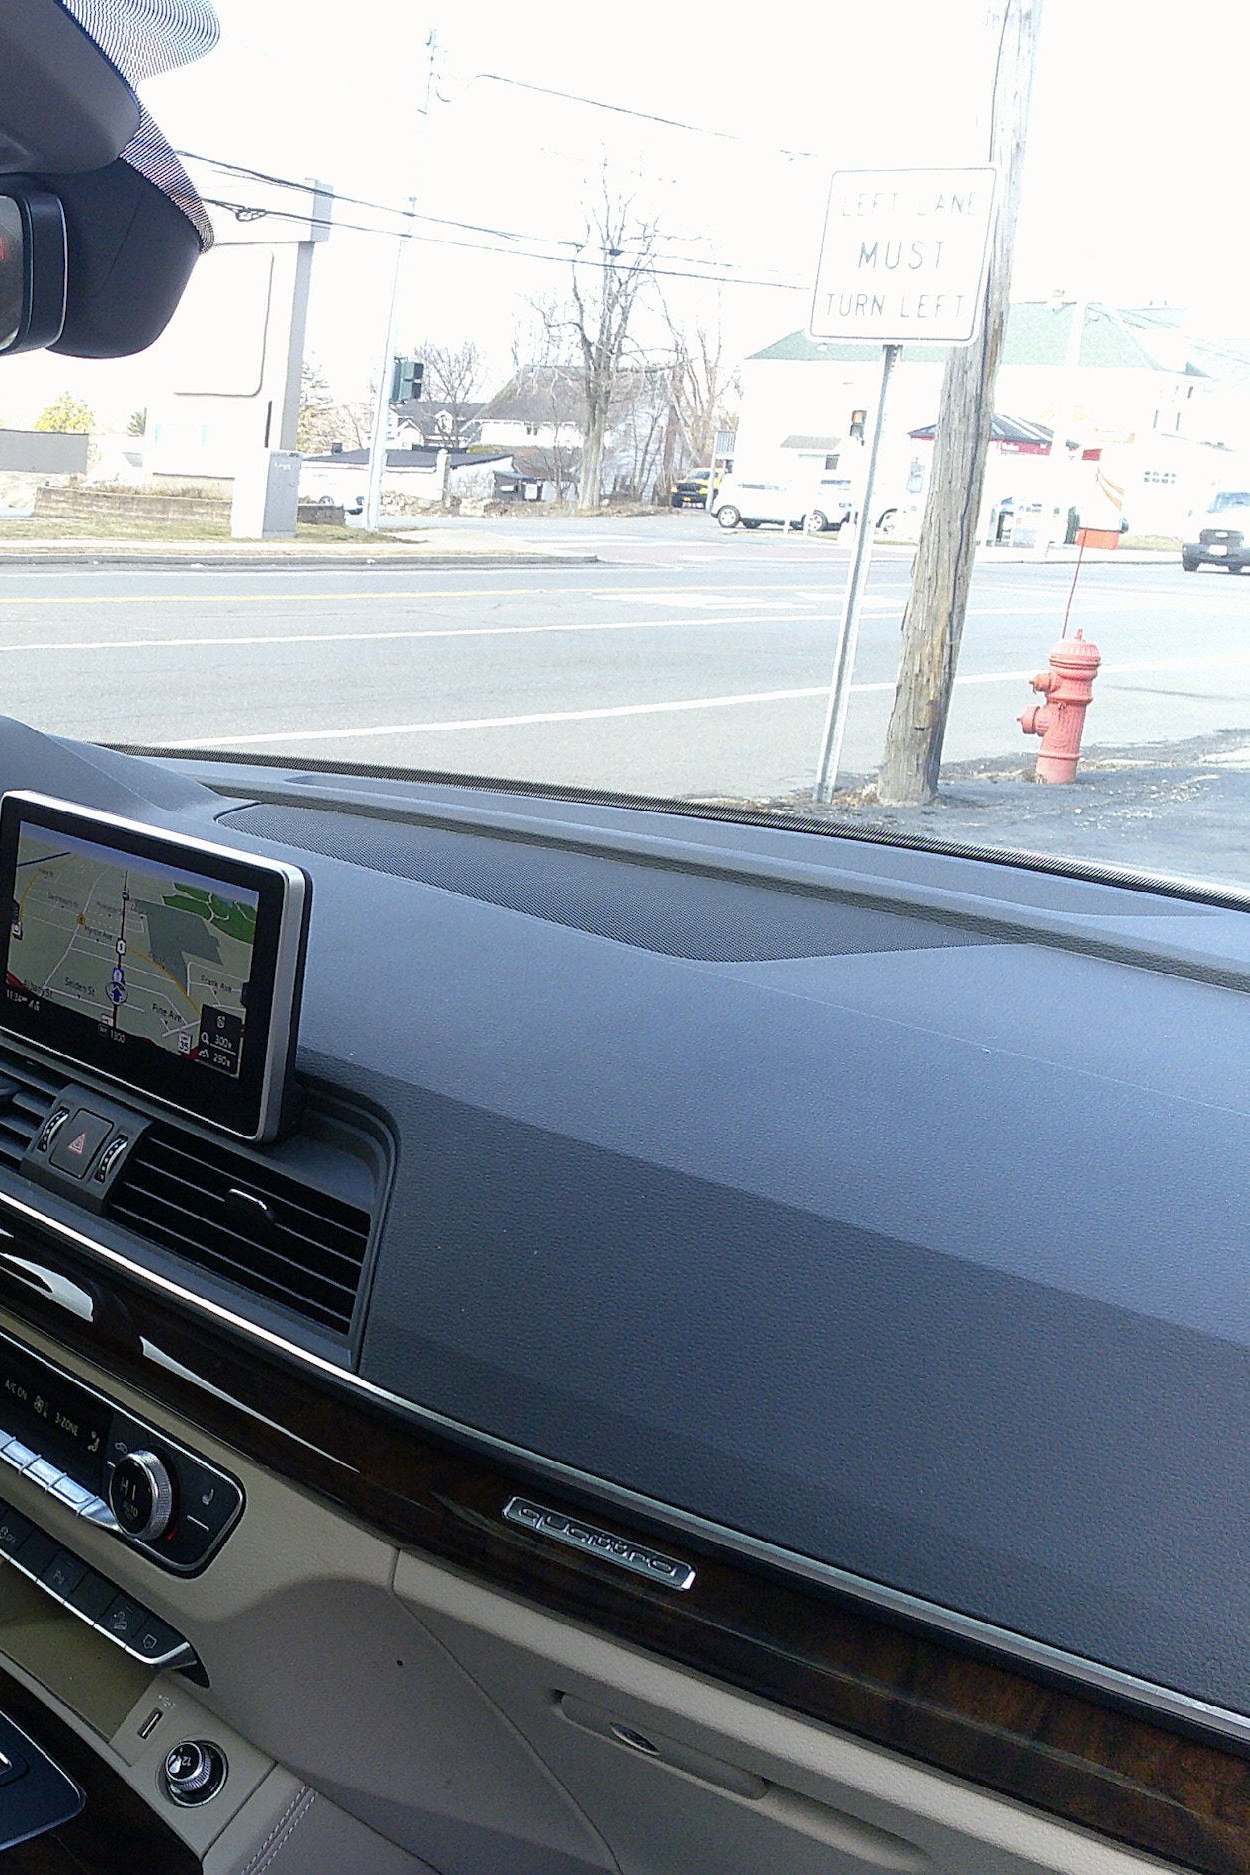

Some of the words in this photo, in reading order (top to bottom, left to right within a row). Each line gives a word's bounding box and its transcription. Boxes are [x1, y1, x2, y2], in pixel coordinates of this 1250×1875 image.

[842, 193, 899, 216] LEFT
[917, 192, 977, 216] LANE
[858, 241, 945, 270] MUST
[827, 293, 885, 317] TURN
[900, 294, 964, 318] LEFT
[5, 1379, 17, 1394] A/C
[17, 1388, 27, 1400] ON
[55, 1412, 78, 1437] 3-ZONE
[518, 1506, 678, 1577] quattro
